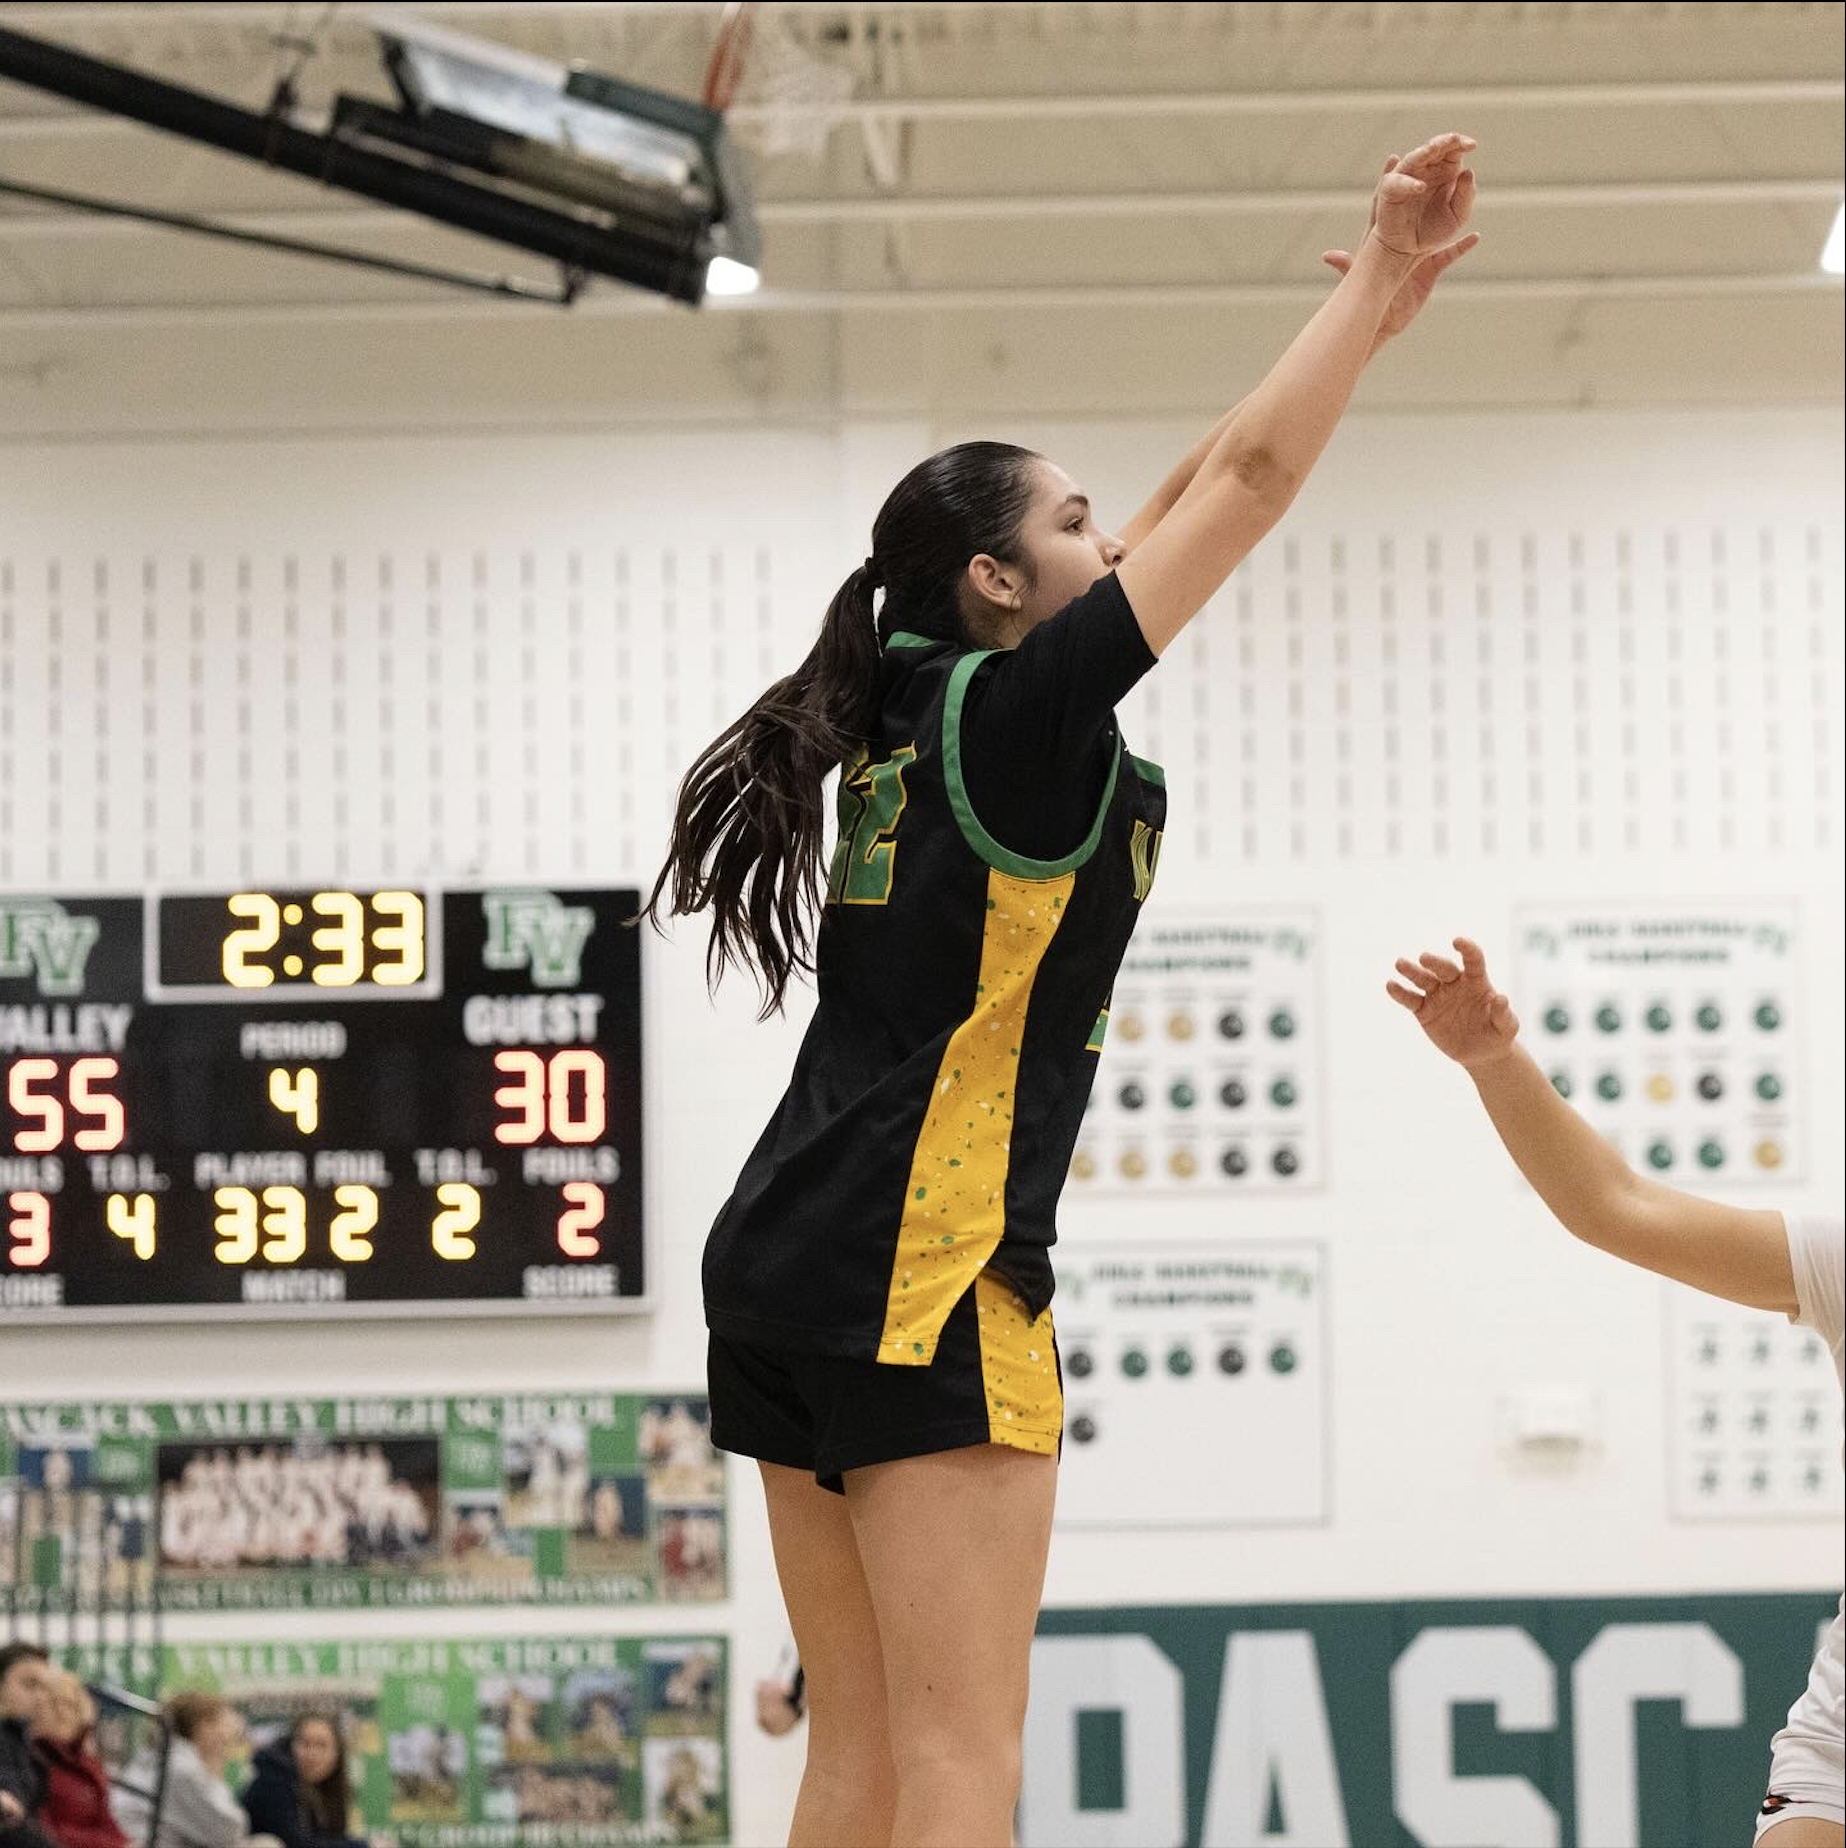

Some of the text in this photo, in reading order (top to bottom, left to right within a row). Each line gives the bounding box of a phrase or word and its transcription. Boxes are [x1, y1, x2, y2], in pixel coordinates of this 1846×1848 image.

[223, 891, 424, 988] 2:33
[0, 1004, 133, 1053] ALLEY
[241, 1022, 346, 1059] PERIOD
[463, 996, 602, 1046] GUEST
[8, 1058, 125, 1152] 55
[269, 1067, 318, 1134] 4
[495, 1050, 606, 1144] 30
[0, 1156, 64, 1193] ULS
[195, 1153, 308, 1186] PLAYER
[522, 1147, 619, 1184] FOULS
[9, 1192, 51, 1266] 3
[107, 1193, 156, 1260] 4
[214, 1185, 379, 1264] 33 2
[432, 1183, 481, 1260] 2
[558, 1182, 605, 1257] 2
[0, 1273, 65, 1306] ORE
[242, 1269, 345, 1304] MATCH
[522, 1265, 619, 1299] SCORE
